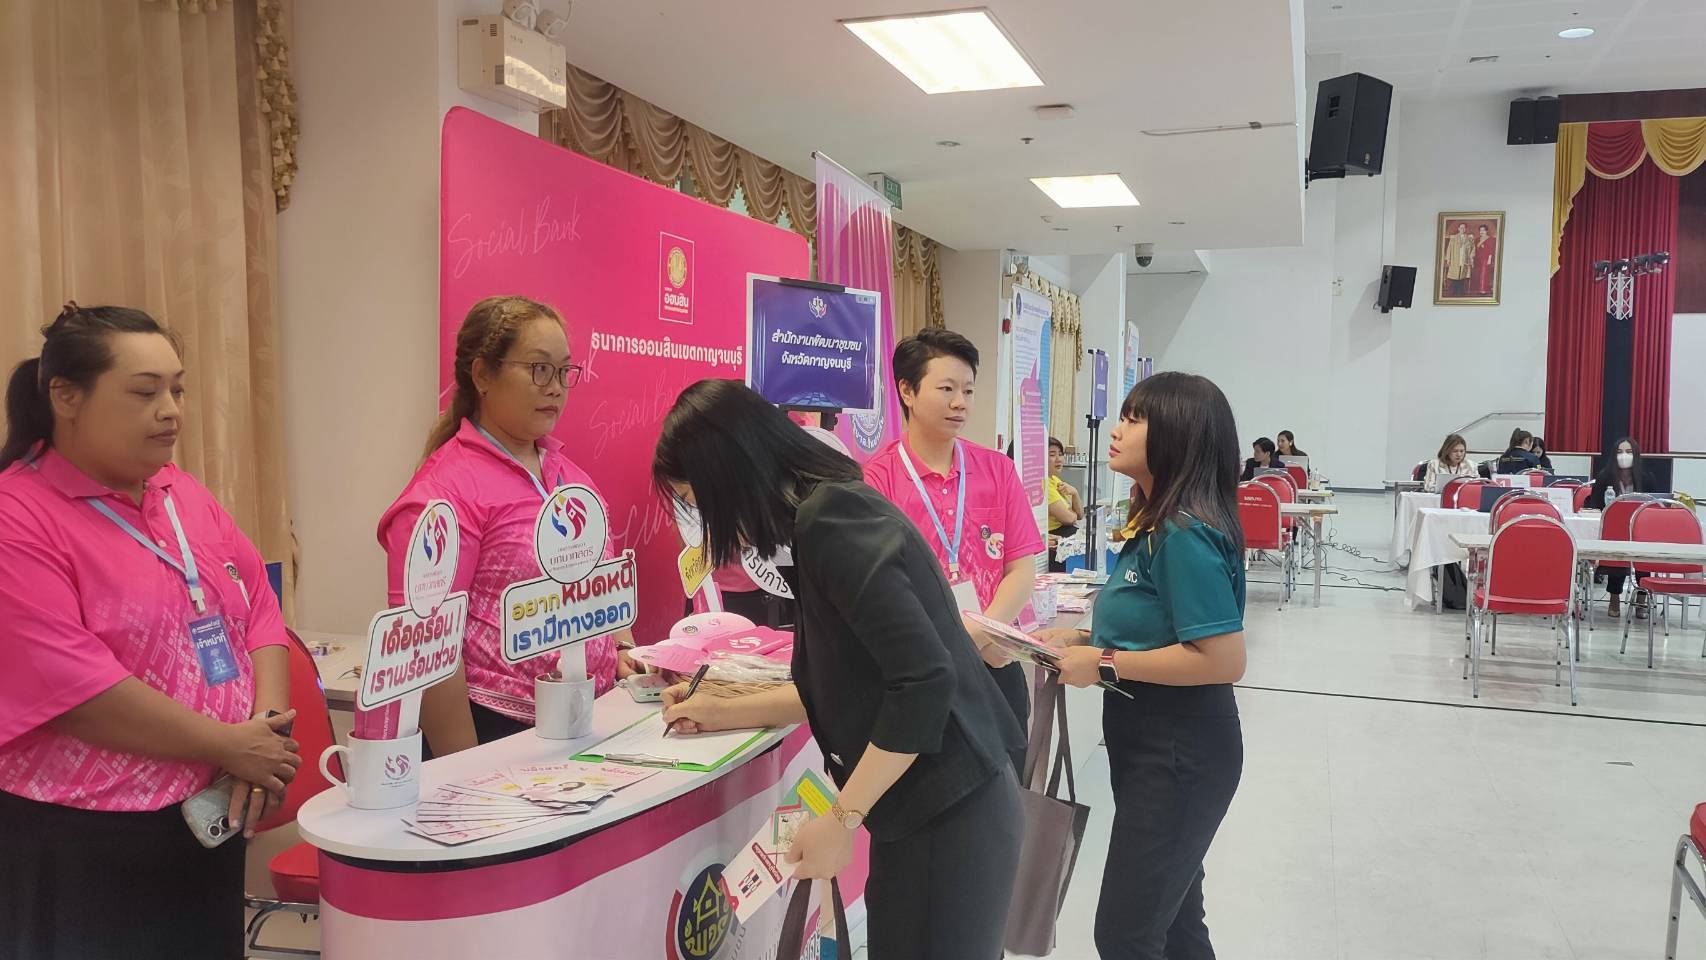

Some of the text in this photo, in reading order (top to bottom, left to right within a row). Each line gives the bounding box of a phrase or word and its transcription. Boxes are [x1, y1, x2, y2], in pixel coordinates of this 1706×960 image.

[448, 195, 581, 278] Social Bank
[591, 332, 743, 371] ธนาคารออมสินเขตกาญจนบุรี
[771, 328, 862, 353] สำนักงานพัฒนาชุมชน
[781, 350, 852, 372] จังหวัดกาญจนบุรี
[197, 629, 225, 649] เจ้าหน้าที่
[512, 601, 631, 653] เรามีทางออก
[370, 638, 458, 695] เราพร้อมช่วย
